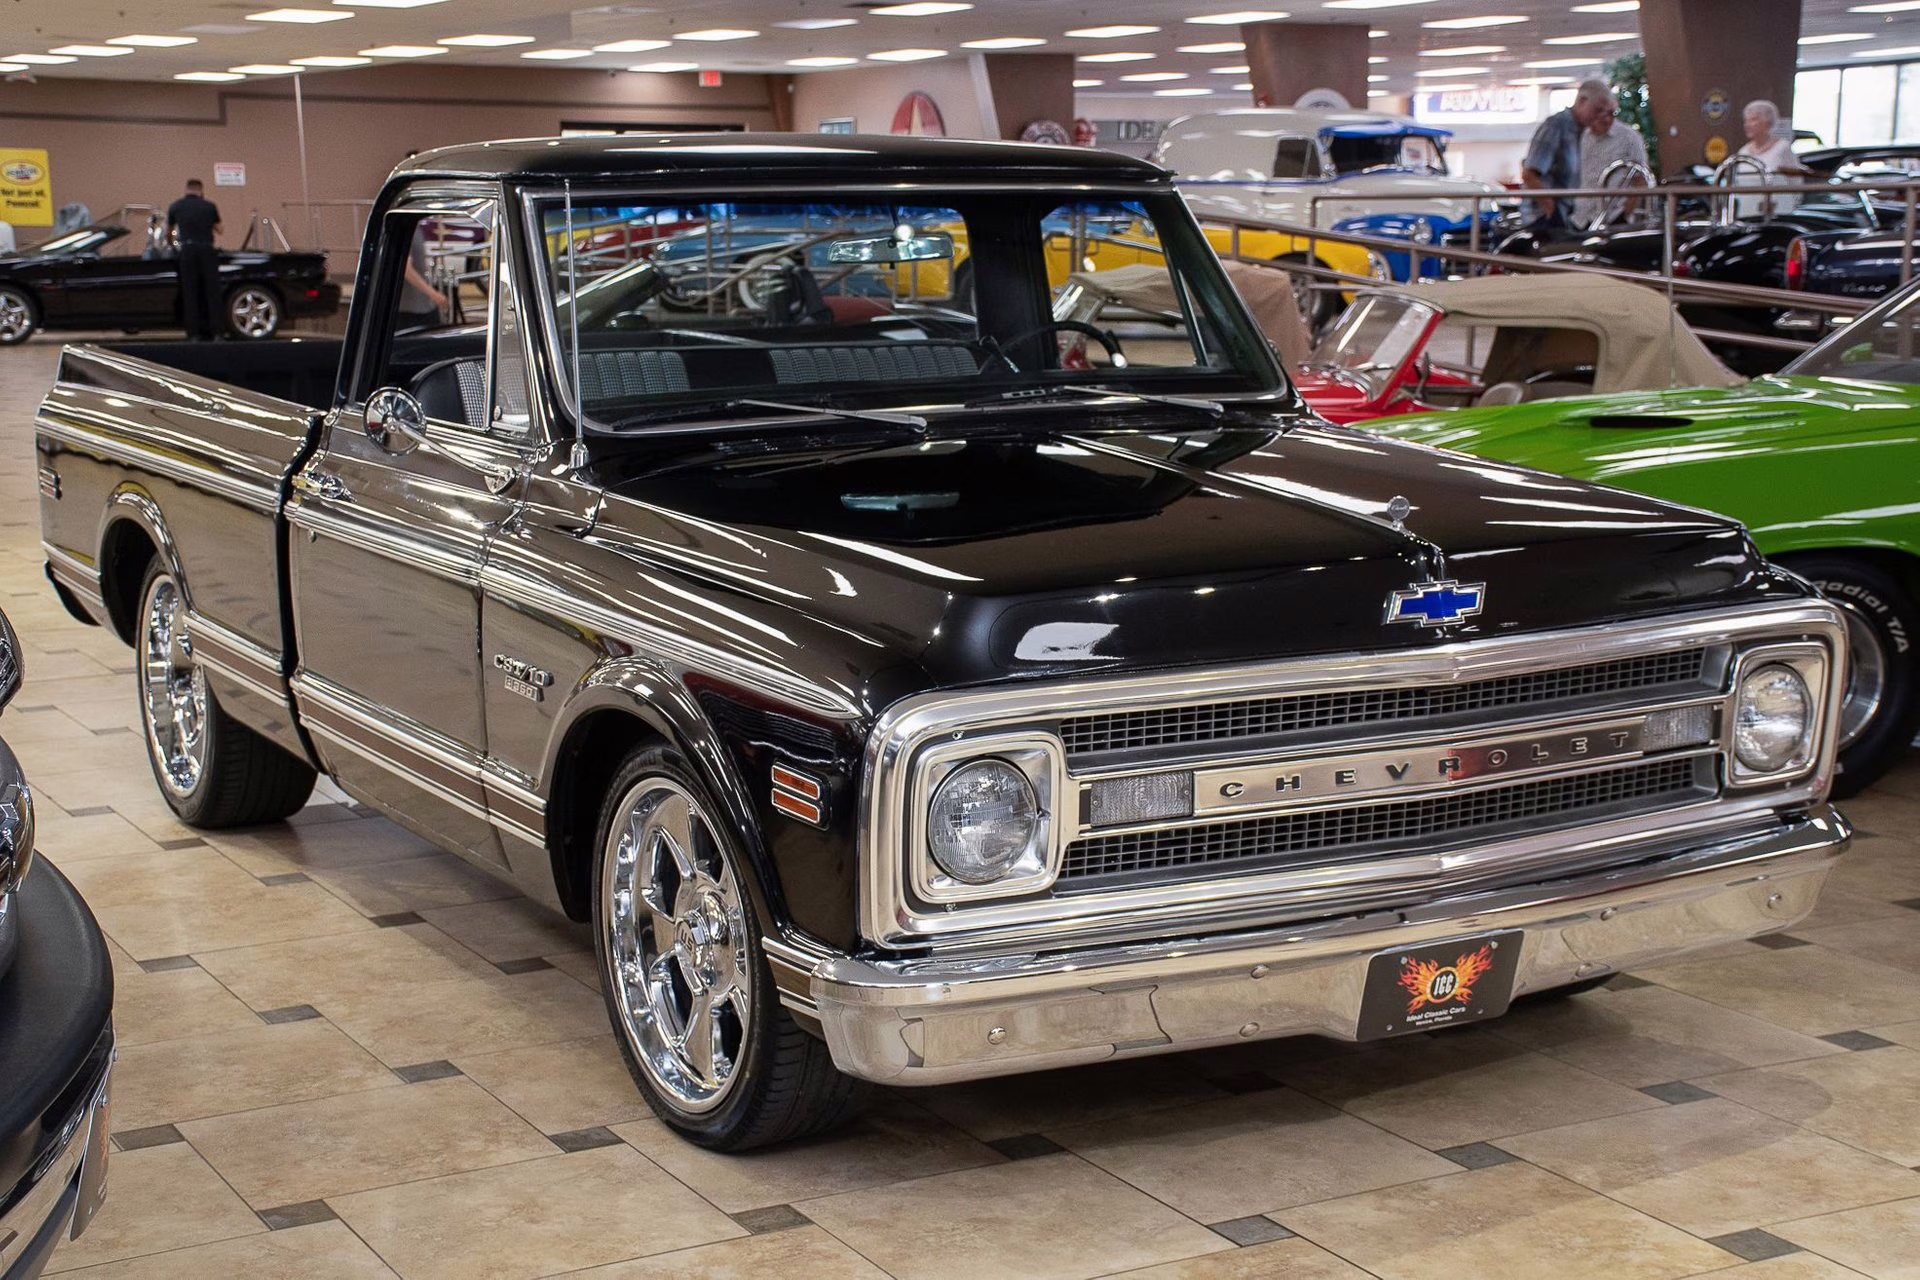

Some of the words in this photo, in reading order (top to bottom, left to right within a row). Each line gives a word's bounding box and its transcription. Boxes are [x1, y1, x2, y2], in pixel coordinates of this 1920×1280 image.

[1886, 615, 1910, 654] T/A
[494, 654, 548, 687] CST/10
[1219, 731, 1629, 799] CHEVROLET
[1406, 1012, 1424, 1022] Ideal
[1424, 1009, 1449, 1019] Classic
[1449, 1006, 1466, 1014] Cars
